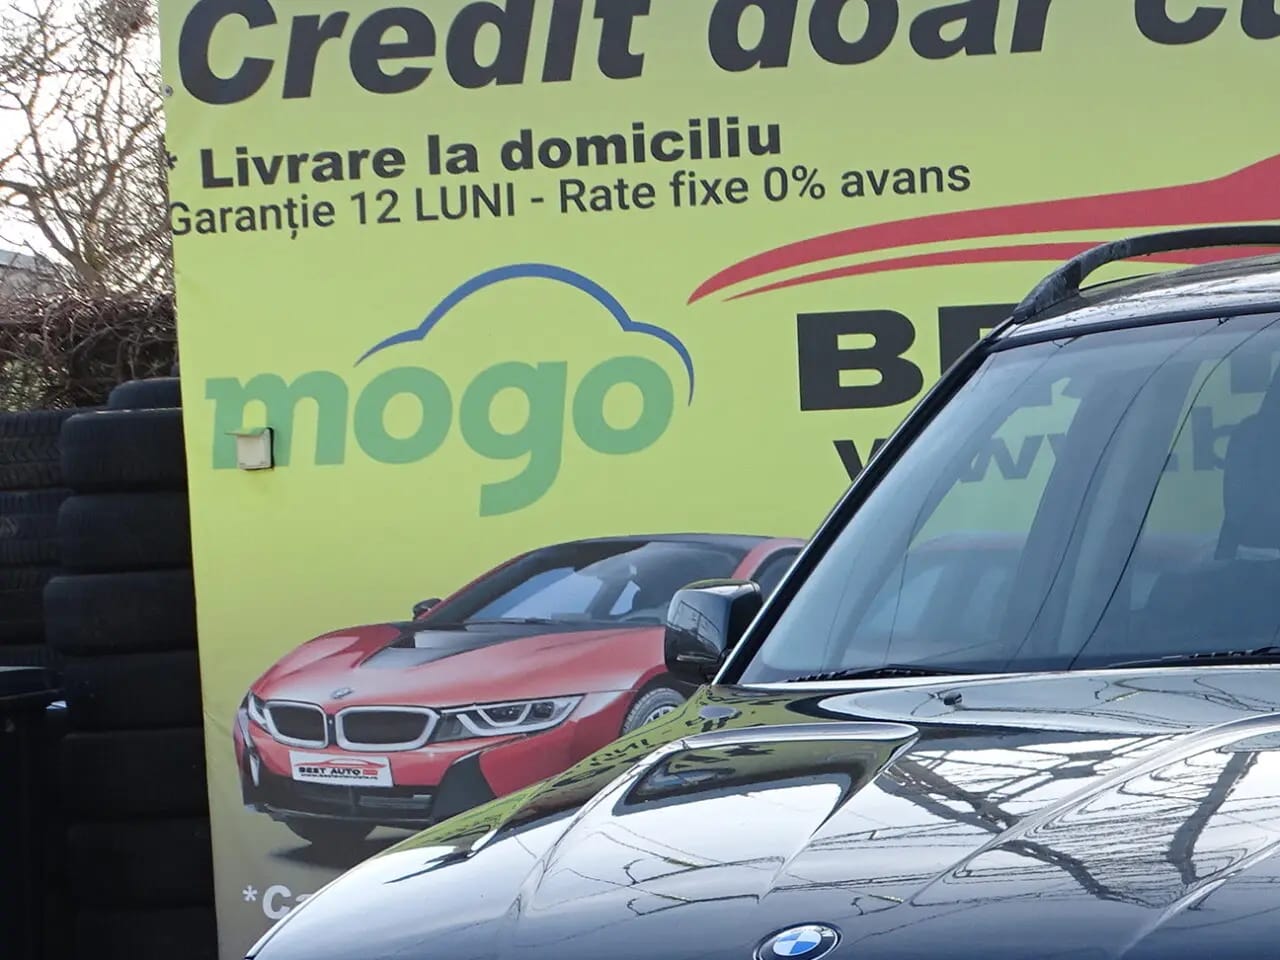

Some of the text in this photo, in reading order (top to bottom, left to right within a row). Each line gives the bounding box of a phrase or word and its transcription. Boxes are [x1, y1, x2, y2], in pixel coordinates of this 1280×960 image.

[178, 0, 650, 105] Credit
[201, 116, 782, 189] Livrare la domiciliu
[351, 189, 401, 225] 12
[415, 182, 515, 222] LUNI
[559, 177, 656, 214] Rate
[669, 170, 749, 208] fixe
[764, 164, 827, 202] 0%
[840, 163, 971, 197] avans
[204, 355, 675, 517] mogo
[298, 766, 327, 775] BEST
[331, 767, 361, 776] AUTO
